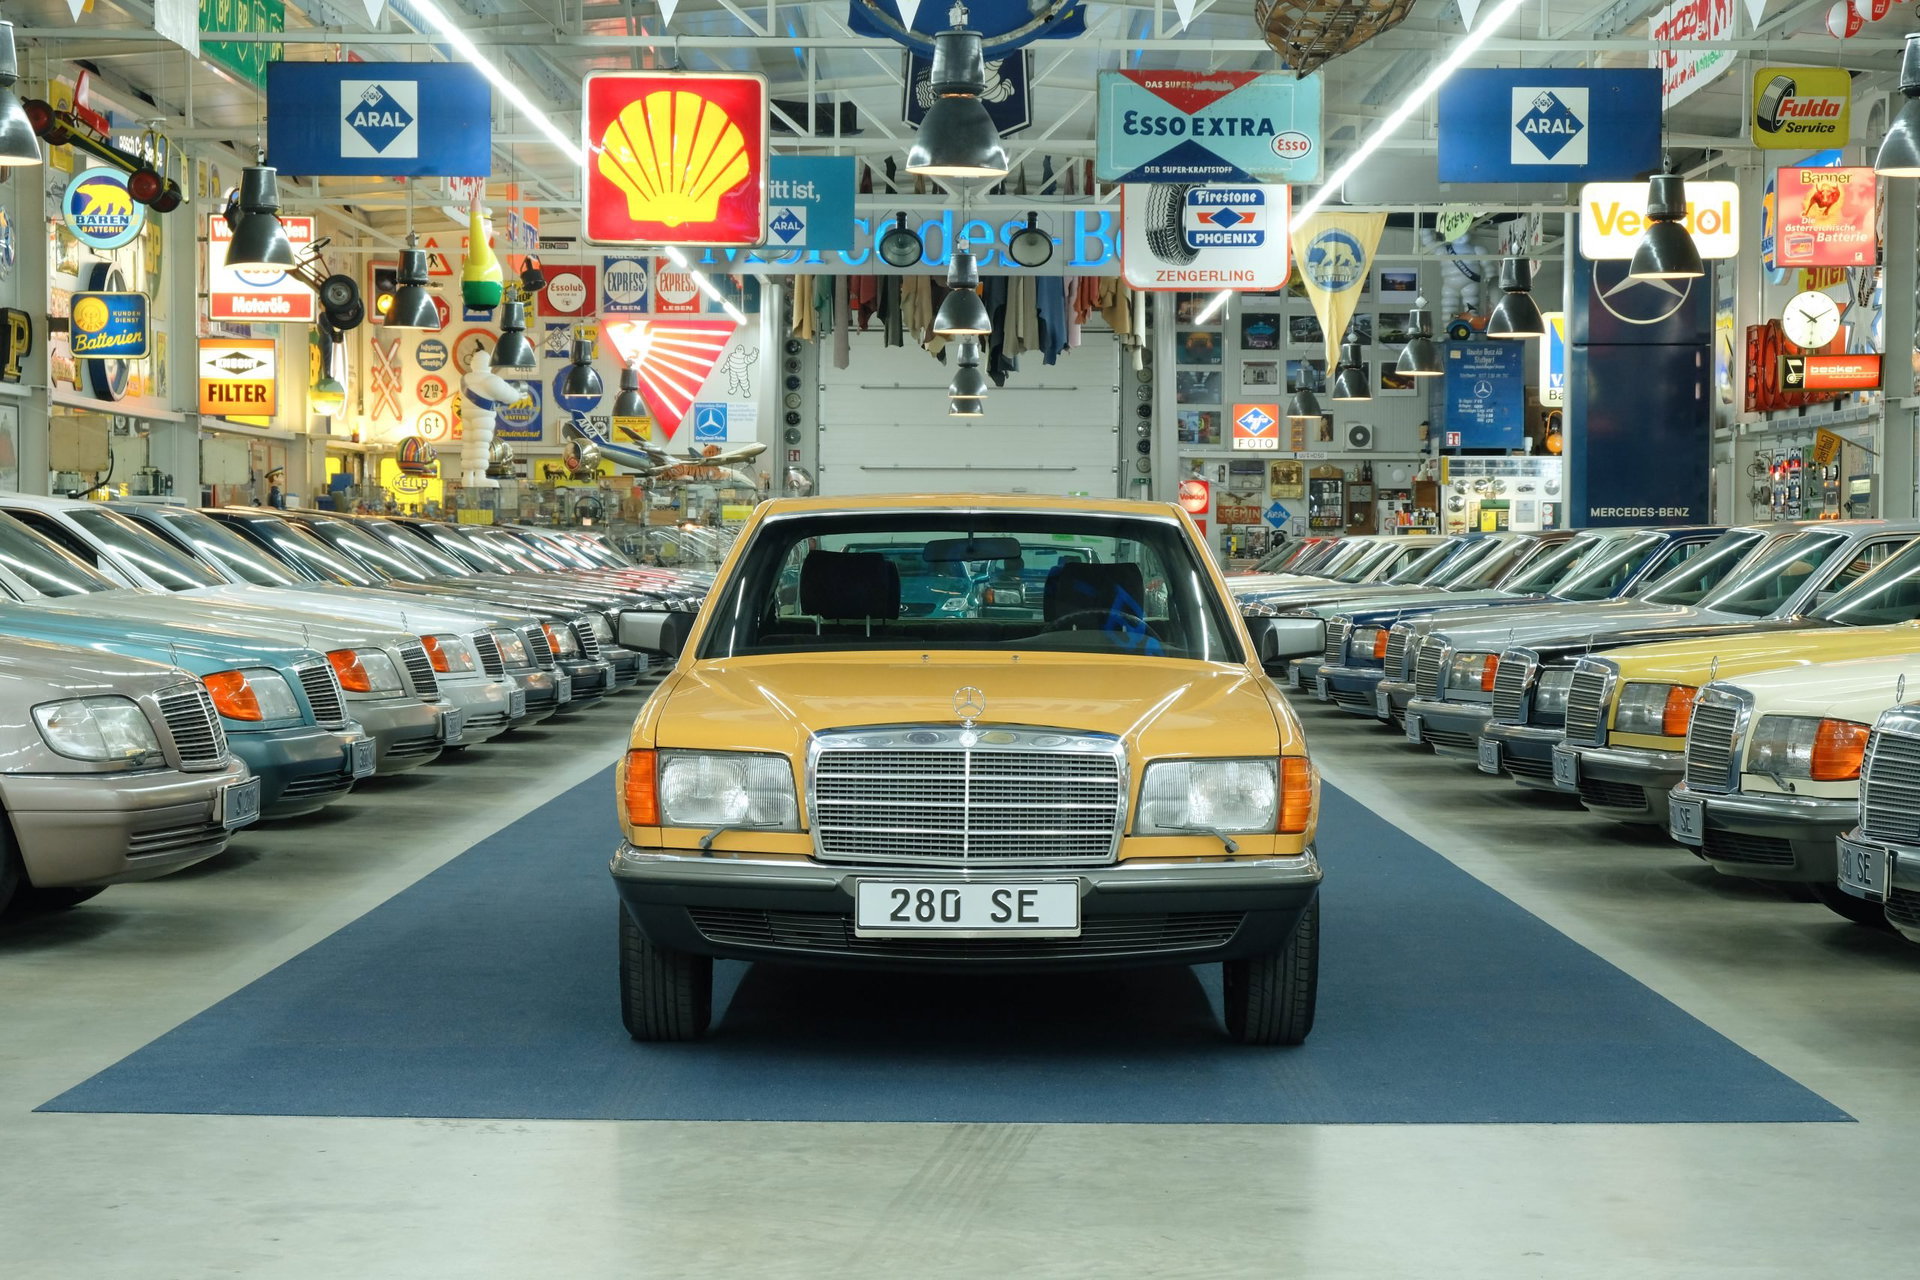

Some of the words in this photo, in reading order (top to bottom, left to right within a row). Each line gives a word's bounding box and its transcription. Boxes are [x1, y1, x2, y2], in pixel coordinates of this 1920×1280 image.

[1144, 80, 1163, 89] DAS
[1778, 98, 1840, 117] Fulda
[353, 111, 406, 128] ARAL
[1523, 118, 1576, 134] ARAL
[1192, 117, 1275, 136] EXTRA
[1785, 122, 1836, 133] Service
[1144, 166, 1160, 174] DER
[1162, 165, 1233, 174] SUPER-KRAFTSTOFF
[1801, 171, 1853, 184] Banner
[792, 181, 821, 203] ist,
[1195, 190, 1257, 204] Firestone
[75, 215, 129, 224] BÄREN
[772, 221, 801, 231] ARAL
[1195, 233, 1258, 244] PHOENIX
[1816, 232, 1869, 243] Batterie
[607, 272, 644, 292] EXPRESS
[660, 272, 696, 292] EXPRESS
[1156, 270, 1255, 282] ZENGERLING
[551, 283, 584, 291] Essolub
[73, 329, 142, 352] Batterien
[1810, 365, 1863, 374] becker
[208, 384, 267, 402] FILTER
[1238, 439, 1274, 448] FOTO
[1590, 507, 1690, 517] MERCEDES-BENZ
[1680, 806, 1692, 833] SE
[1857, 851, 1872, 885] SE
[889, 888, 962, 923] 280
[989, 888, 1040, 923] SE
